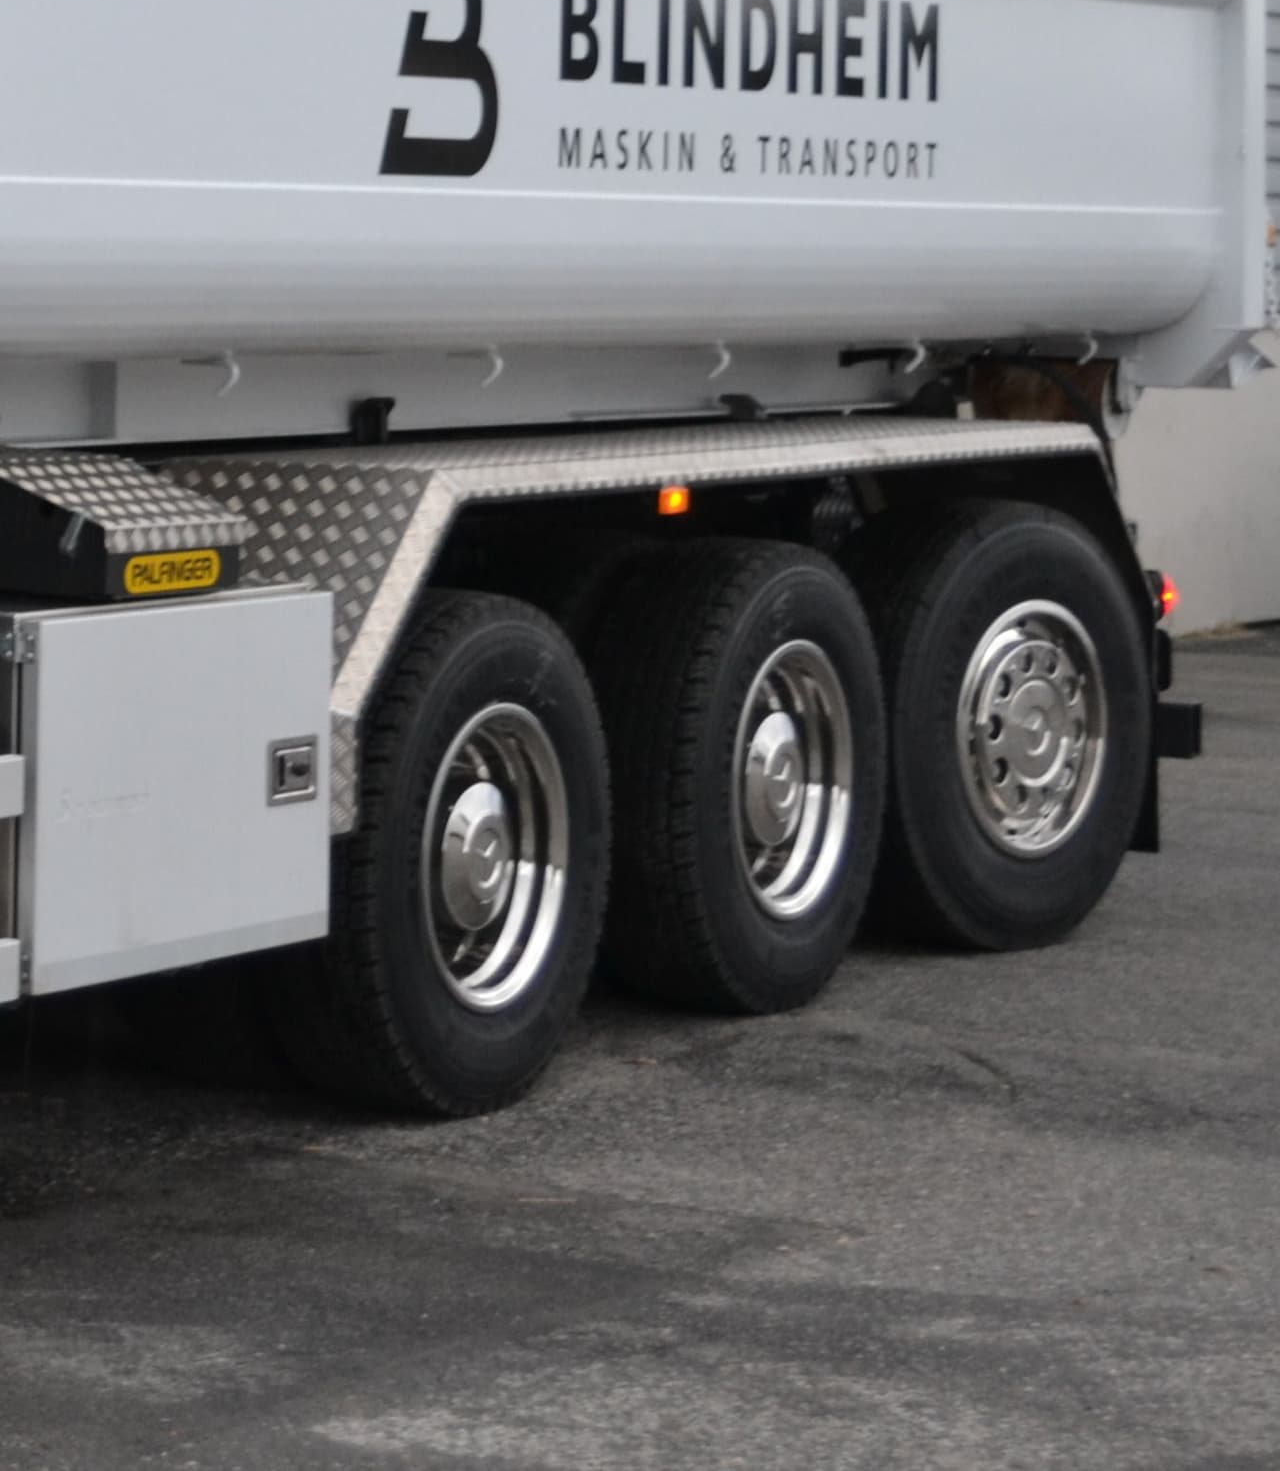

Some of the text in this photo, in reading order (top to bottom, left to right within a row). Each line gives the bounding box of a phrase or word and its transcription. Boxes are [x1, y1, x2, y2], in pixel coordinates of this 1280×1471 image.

[557, 127, 938, 179] MASKIN & TRANSPORT
